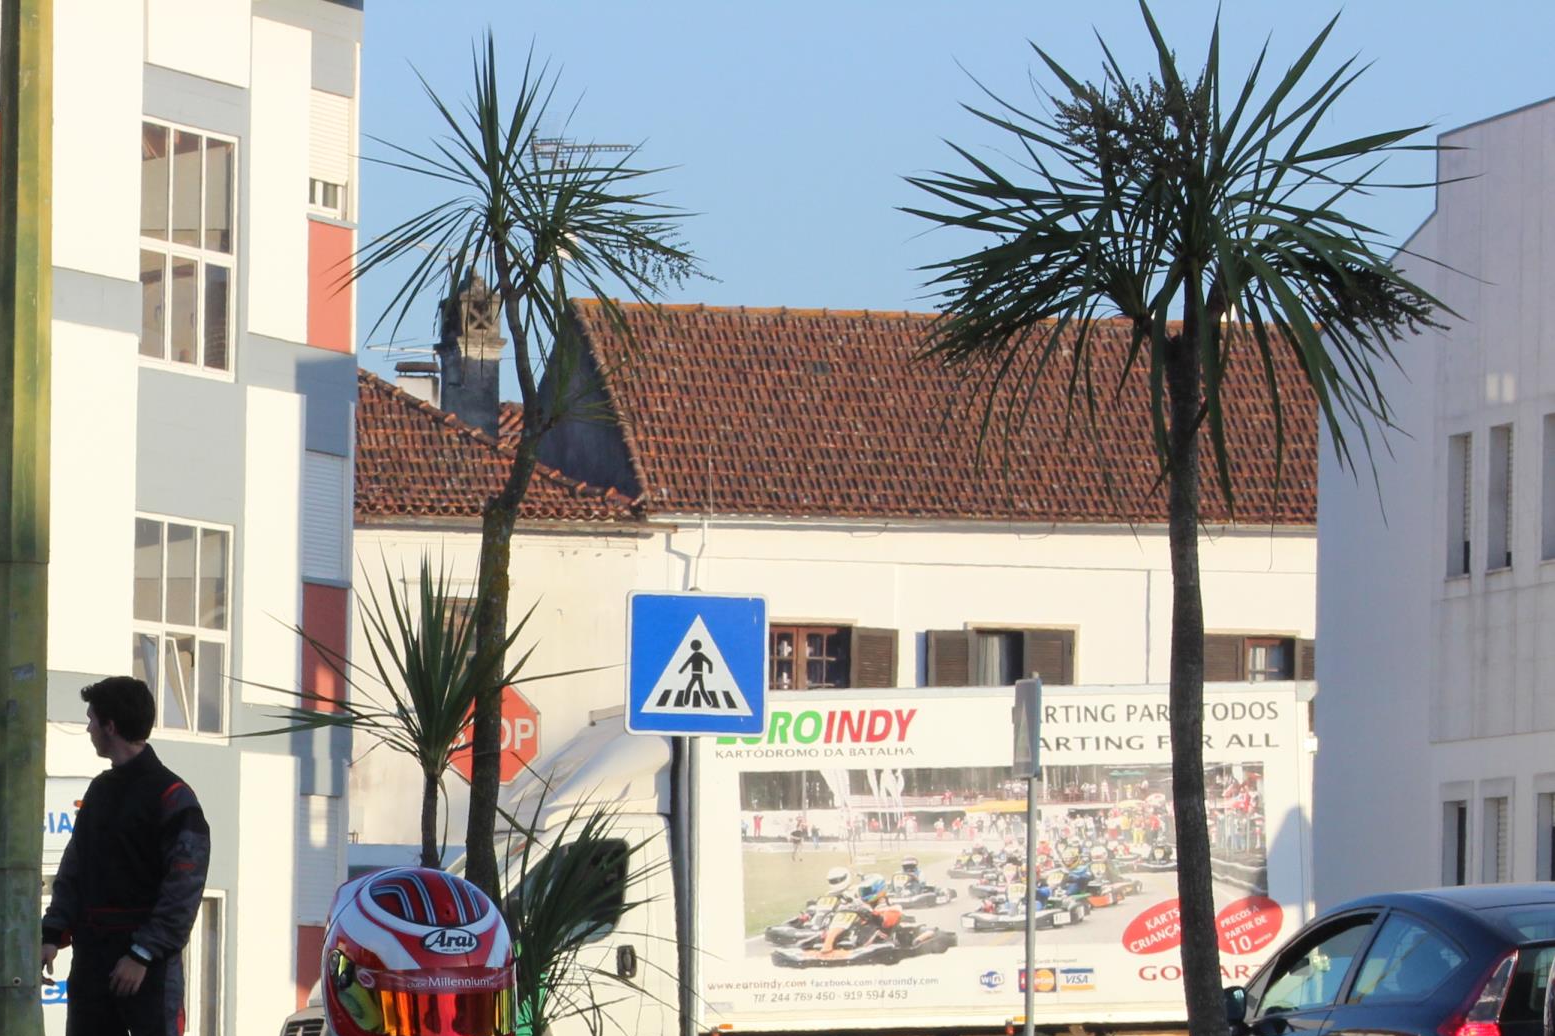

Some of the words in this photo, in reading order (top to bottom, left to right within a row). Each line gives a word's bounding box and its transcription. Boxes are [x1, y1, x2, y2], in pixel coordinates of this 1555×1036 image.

[1126, 704, 1170, 722] PAR
[716, 709, 917, 745] ROINDY
[1039, 736, 1144, 751] ARTING
[1158, 734, 1213, 750] FR
[1226, 733, 1280, 748] ALL
[824, 748, 845, 757] DA
[849, 747, 915, 757] BATALHA
[429, 931, 474, 948] Arai
[1229, 935, 1252, 955] 10
[1066, 975, 1088, 985] VISA
[771, 993, 790, 1003] 244
[816, 992, 836, 1001] 450
[888, 990, 908, 999] 453
